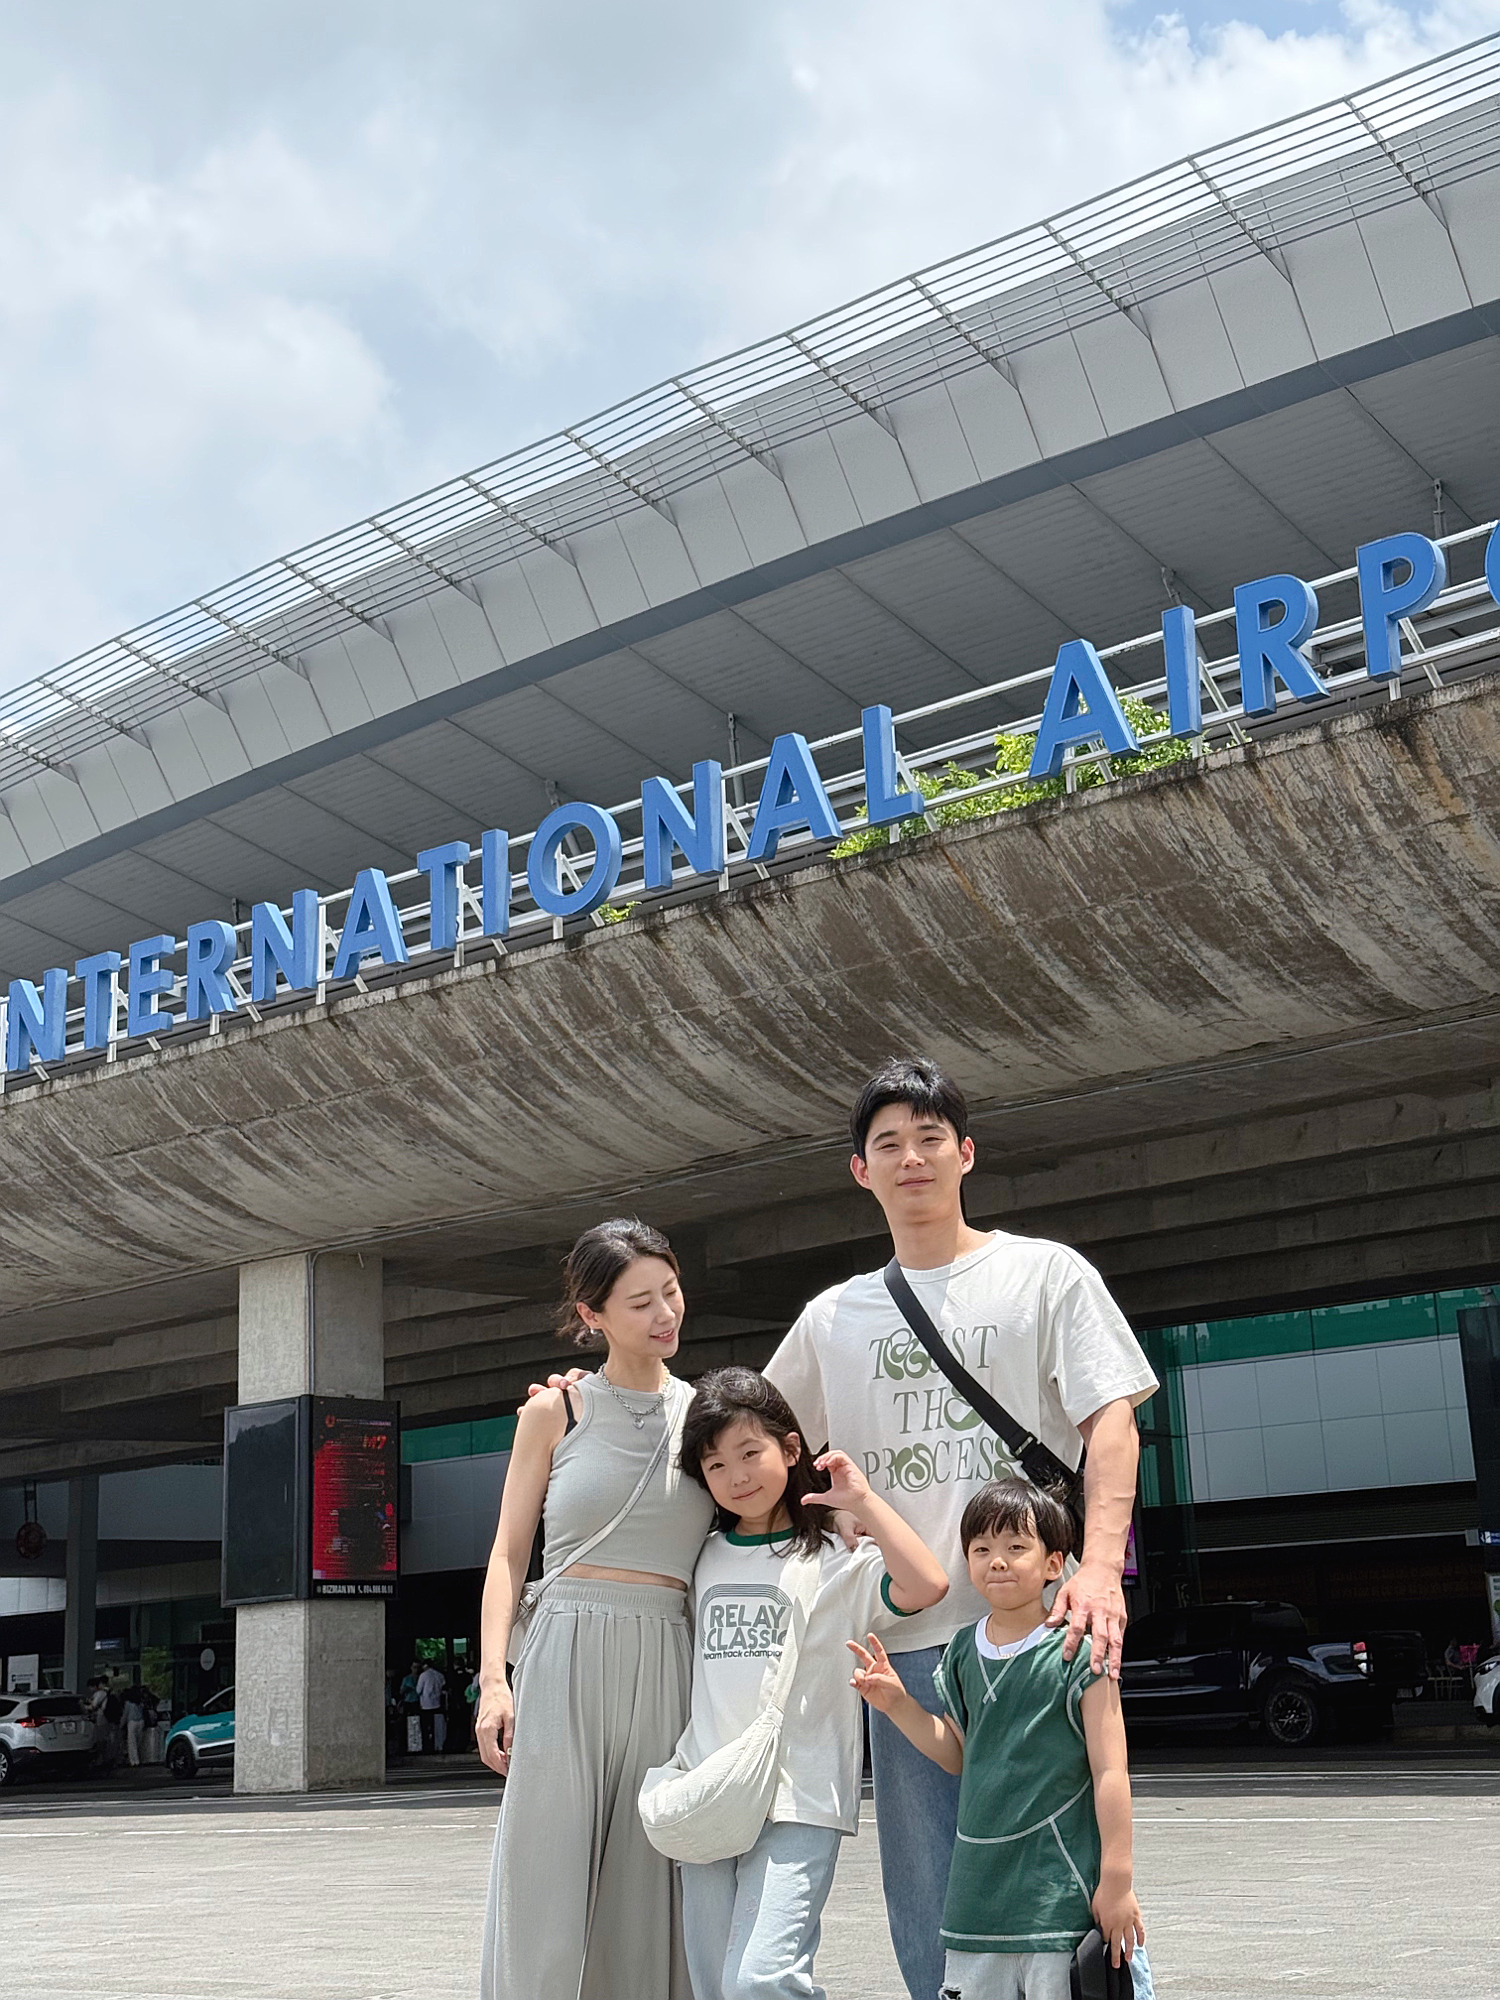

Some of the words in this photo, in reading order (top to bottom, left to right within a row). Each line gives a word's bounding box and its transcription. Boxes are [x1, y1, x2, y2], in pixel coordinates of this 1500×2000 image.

[7, 704, 924, 1072] NTERNATIONAL
[1029, 519, 1500, 782] AIRP
[709, 1604, 787, 1629] RELAY
[706, 1627, 787, 1652] CLASSIC
[723, 1650, 743, 1659] track
